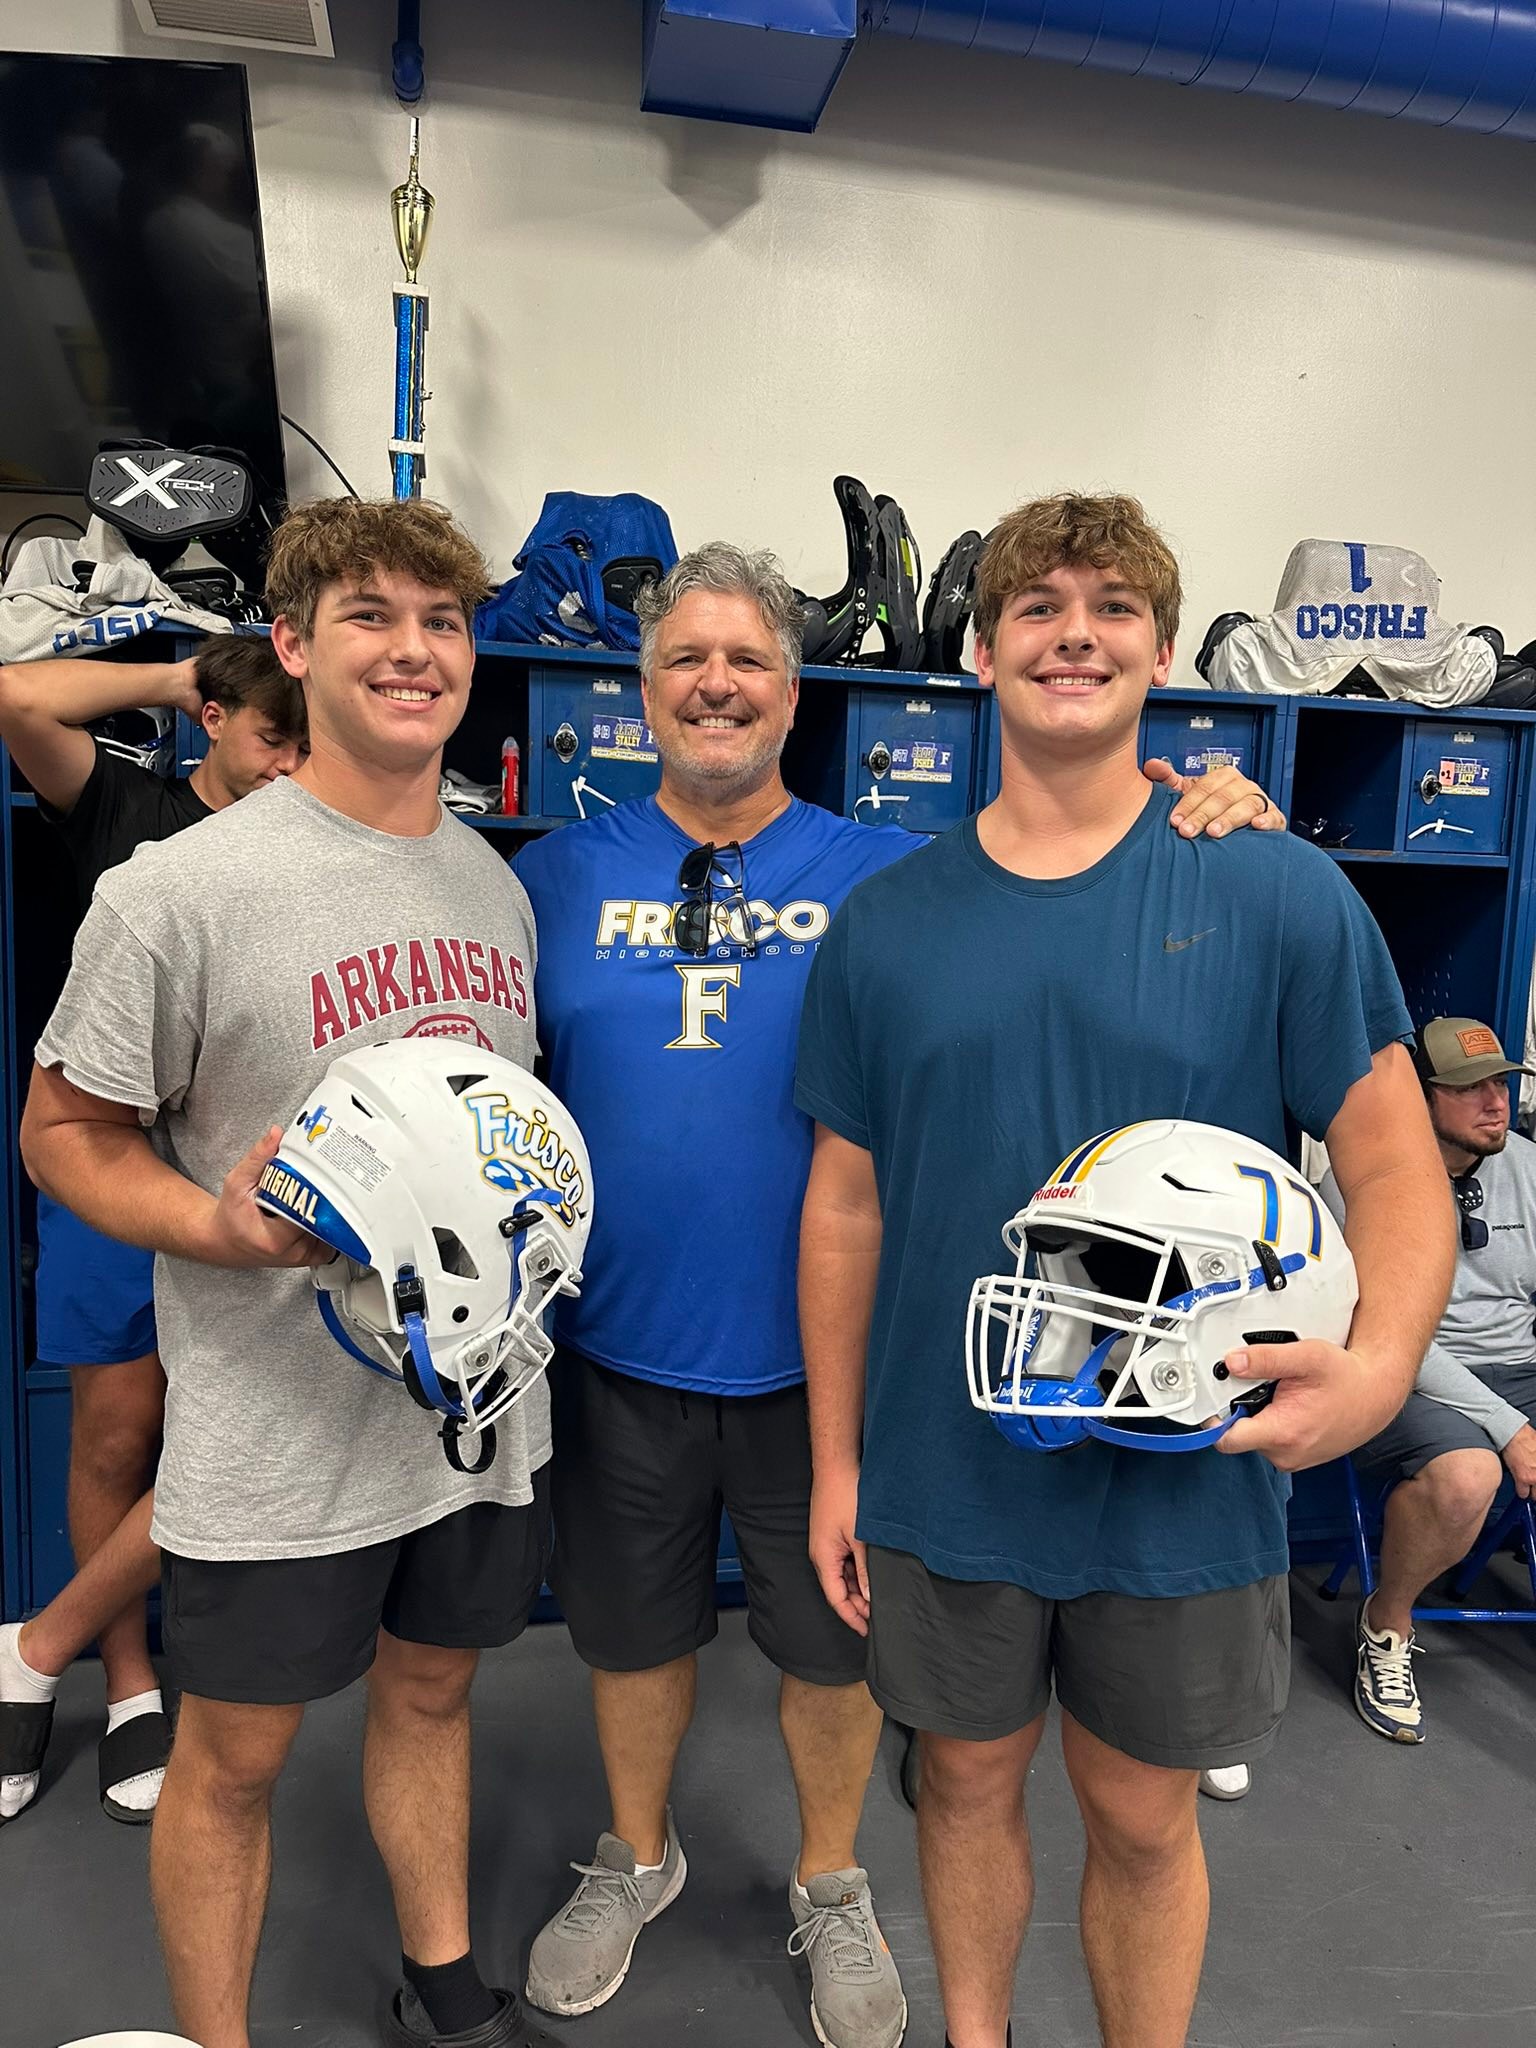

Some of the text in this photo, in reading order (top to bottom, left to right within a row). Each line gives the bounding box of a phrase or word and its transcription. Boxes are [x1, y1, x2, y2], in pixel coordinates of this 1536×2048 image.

[1343, 541, 1374, 594] 1
[1296, 602, 1429, 641] FRISCO
[613, 724, 643, 737] AARON
[615, 735, 641, 747] STALEY
[940, 752, 950, 765] F
[1480, 767, 1490, 780] F
[595, 942, 821, 962] HIGH CHOO
[309, 935, 530, 1053] ARKANSAS
[663, 963, 742, 1050] F
[353, 1133, 378, 1155] WARNING
[464, 1093, 585, 1208] Frisco
[258, 1163, 319, 1226] RIGINAL
[1232, 1161, 1323, 1263] 77
[1491, 1223, 1526, 1232] patagonia
